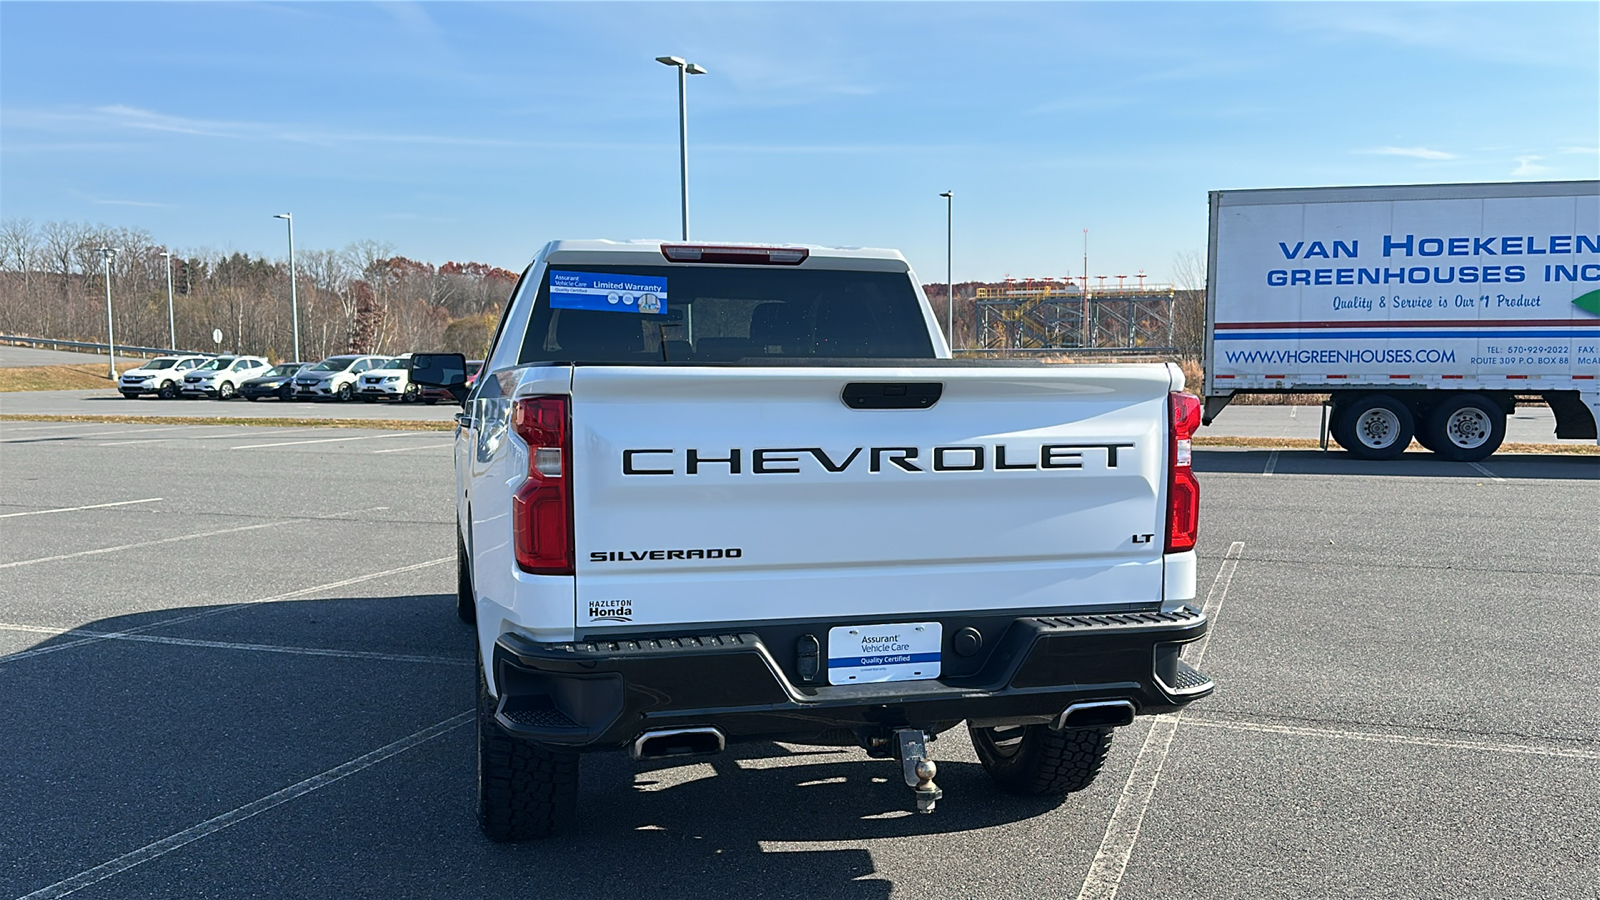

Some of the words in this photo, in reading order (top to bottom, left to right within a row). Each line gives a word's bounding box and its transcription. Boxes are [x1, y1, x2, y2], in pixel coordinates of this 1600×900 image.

[1279, 240, 1359, 260] VAN
[1382, 234, 1600, 257] HOEKELEN
[1267, 265, 1526, 286] GREENHOUSES
[1545, 264, 1600, 282] INC
[593, 281, 623, 290] Limited
[625, 283, 662, 293] Warranty
[1333, 296, 1373, 312] Quality
[1379, 296, 1386, 308] &
[1393, 295, 1433, 309] Service
[1438, 296, 1448, 308] is
[1455, 295, 1475, 308] Our
[1496, 294, 1541, 307] Product
[1487, 346, 1503, 354] TEL:
[1225, 349, 1456, 364] WWW.VHGREENHOUSES.COM
[1470, 357, 1497, 365] ROUTE
[1499, 357, 1516, 365] 309
[1538, 357, 1557, 365] BOX
[1558, 357, 1569, 365] 88
[1577, 357, 1600, 365] McA
[622, 442, 1135, 475] CHEVROLET
[1132, 533, 1155, 544] LT
[589, 548, 742, 562] SILVERADO
[589, 599, 632, 608] HAZLETON
[589, 606, 632, 617] Honda
[861, 635, 899, 643] Assurant
[861, 644, 890, 652] Vehicle
[891, 643, 910, 651] Care
[861, 656, 883, 664] Quality
[884, 655, 911, 663] Certified
